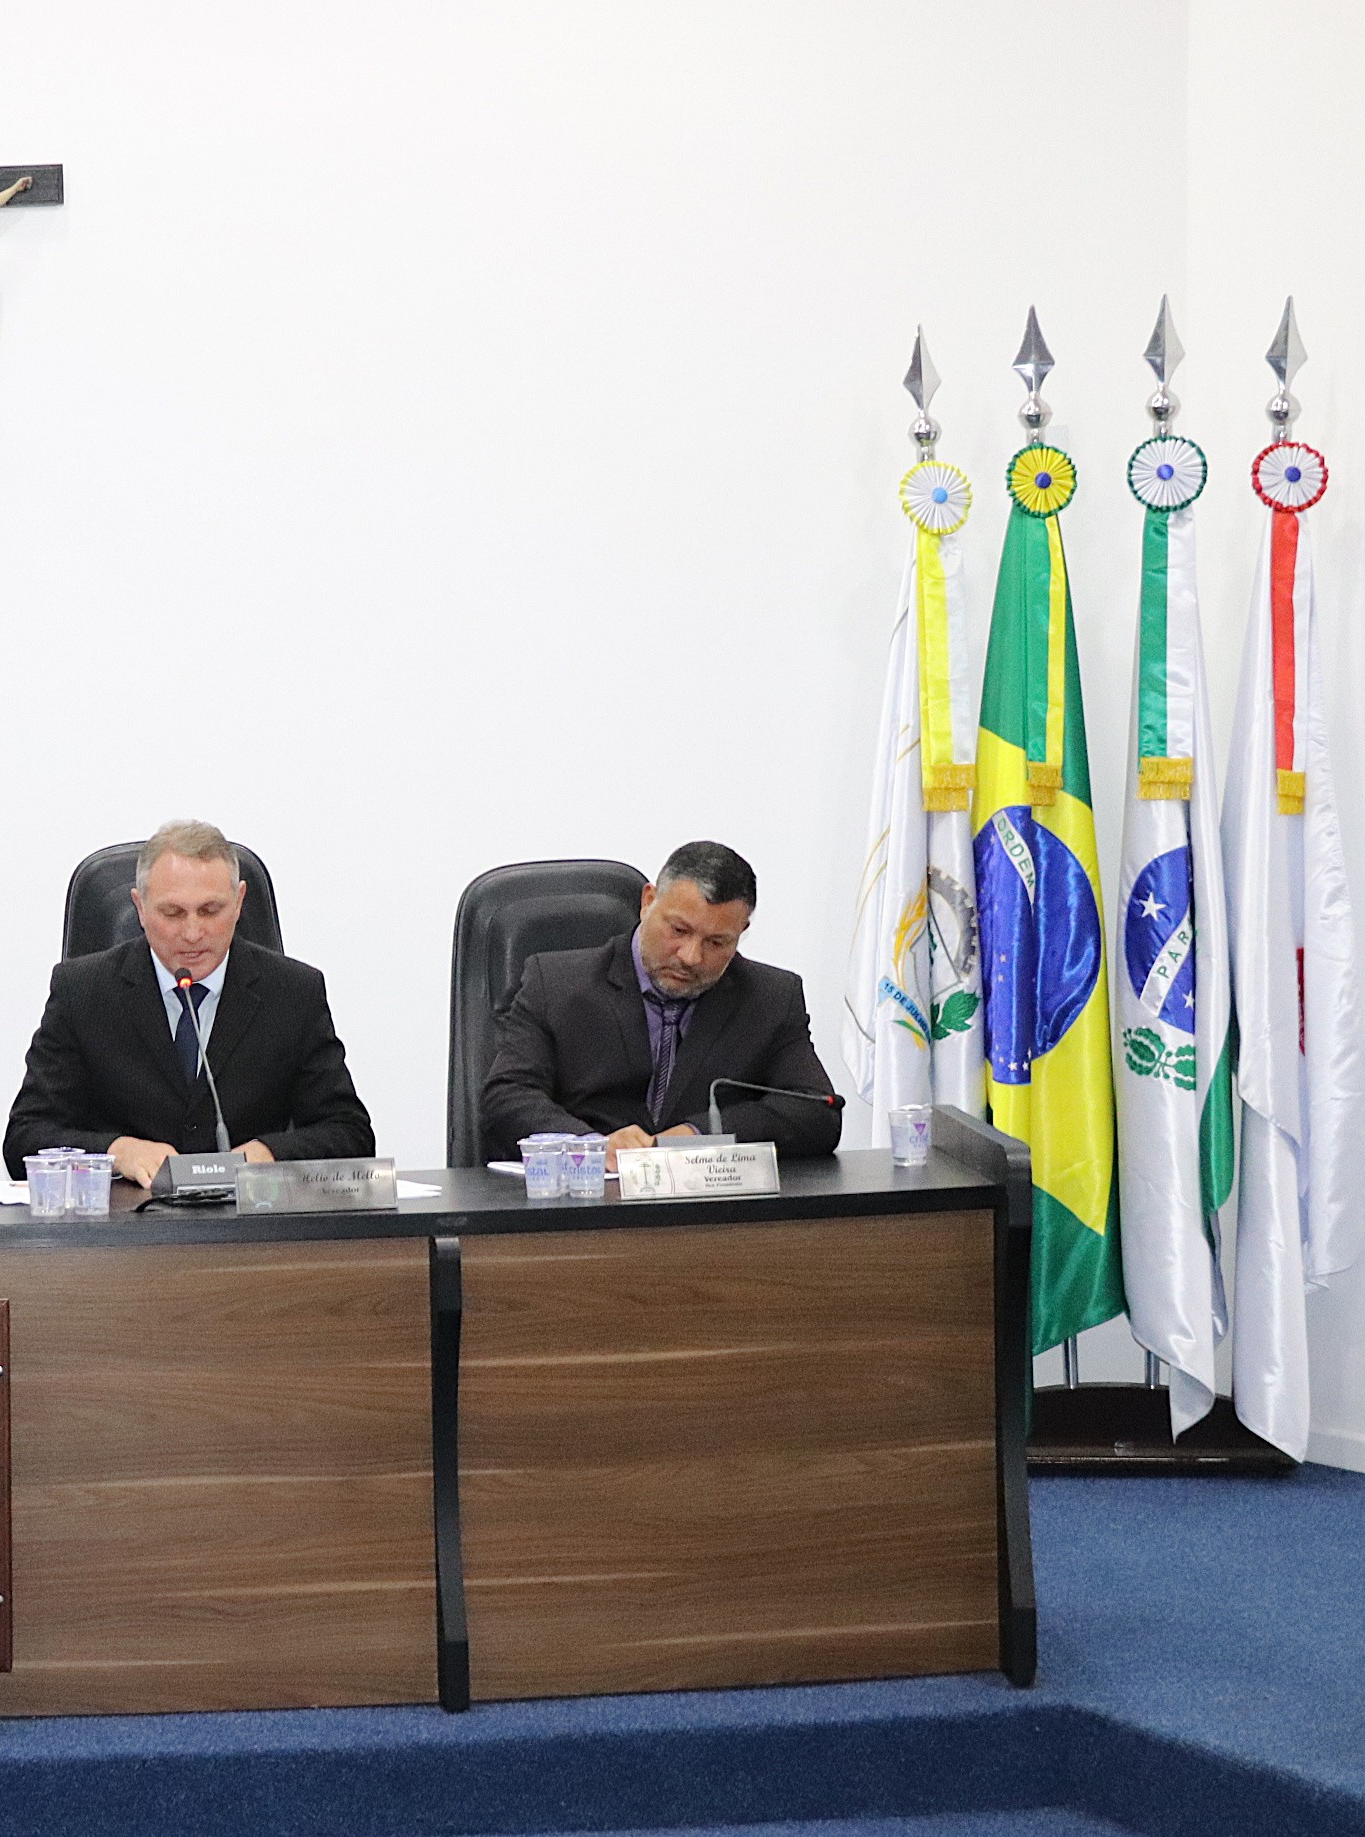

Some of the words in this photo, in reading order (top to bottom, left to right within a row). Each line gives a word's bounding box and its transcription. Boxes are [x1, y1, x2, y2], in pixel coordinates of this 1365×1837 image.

[997, 817, 1035, 888] ORDEM
[1156, 918, 1193, 979] PAR
[884, 983, 895, 993] 15
[894, 992, 907, 1005] DE
[685, 1155, 713, 1165] Selmo
[716, 1153, 726, 1163] de
[192, 1164, 226, 1175] Riole
[332, 1171, 345, 1182] de
